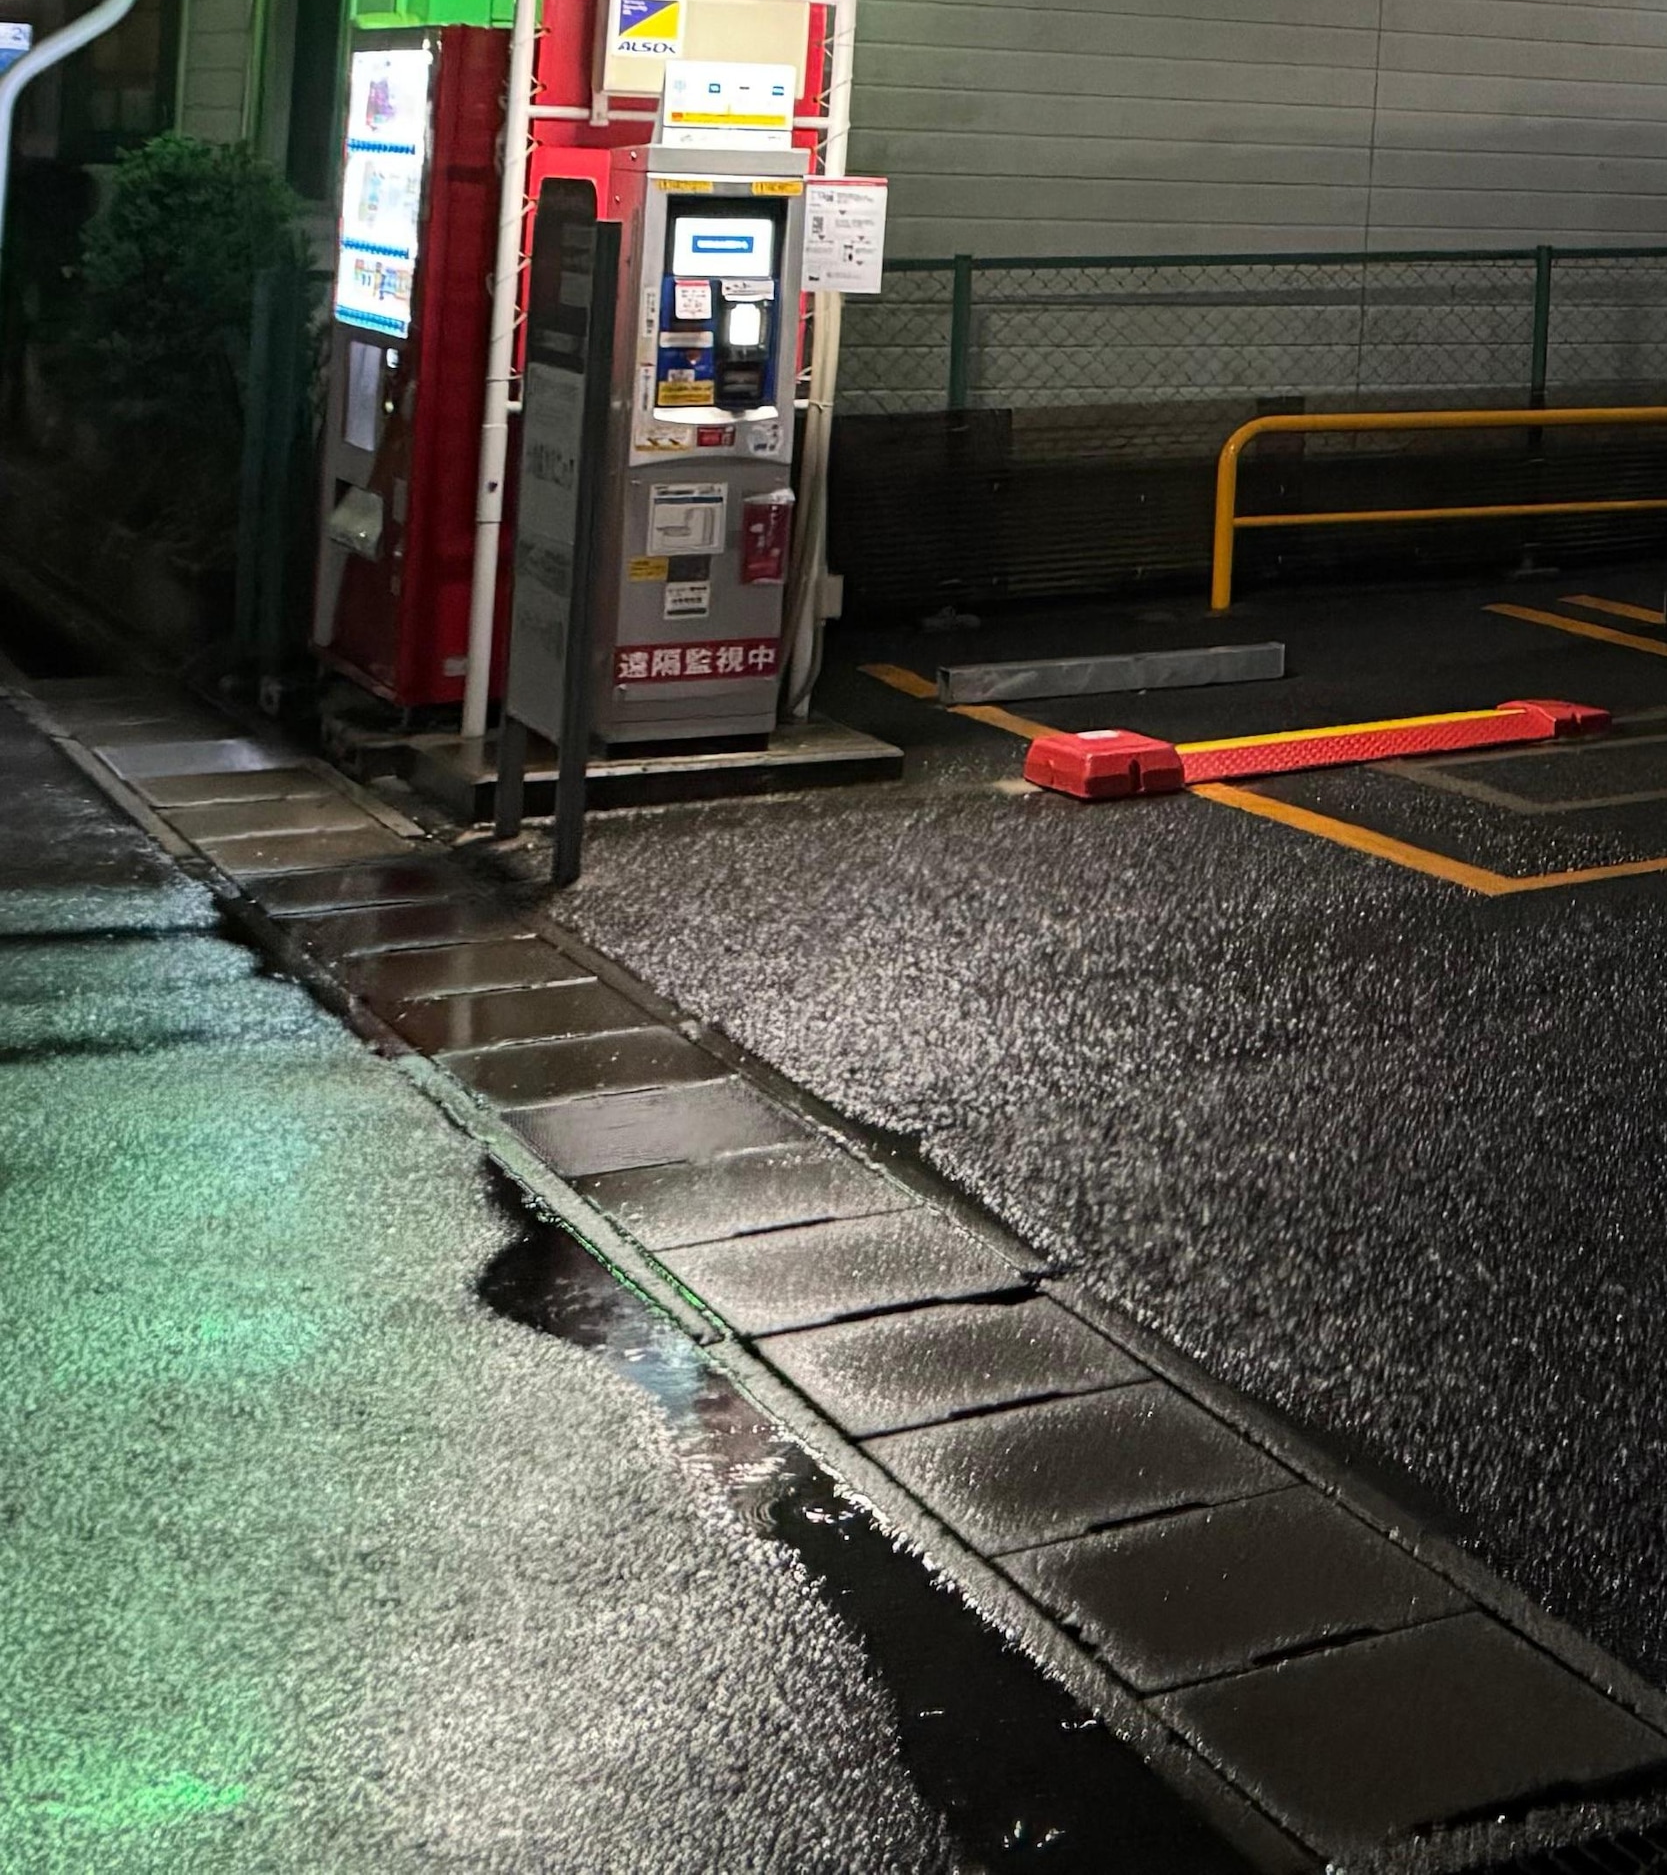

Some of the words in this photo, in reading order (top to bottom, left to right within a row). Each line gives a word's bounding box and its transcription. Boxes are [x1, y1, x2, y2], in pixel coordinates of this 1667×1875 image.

[617, 644, 777, 680] 遠隔監視中
